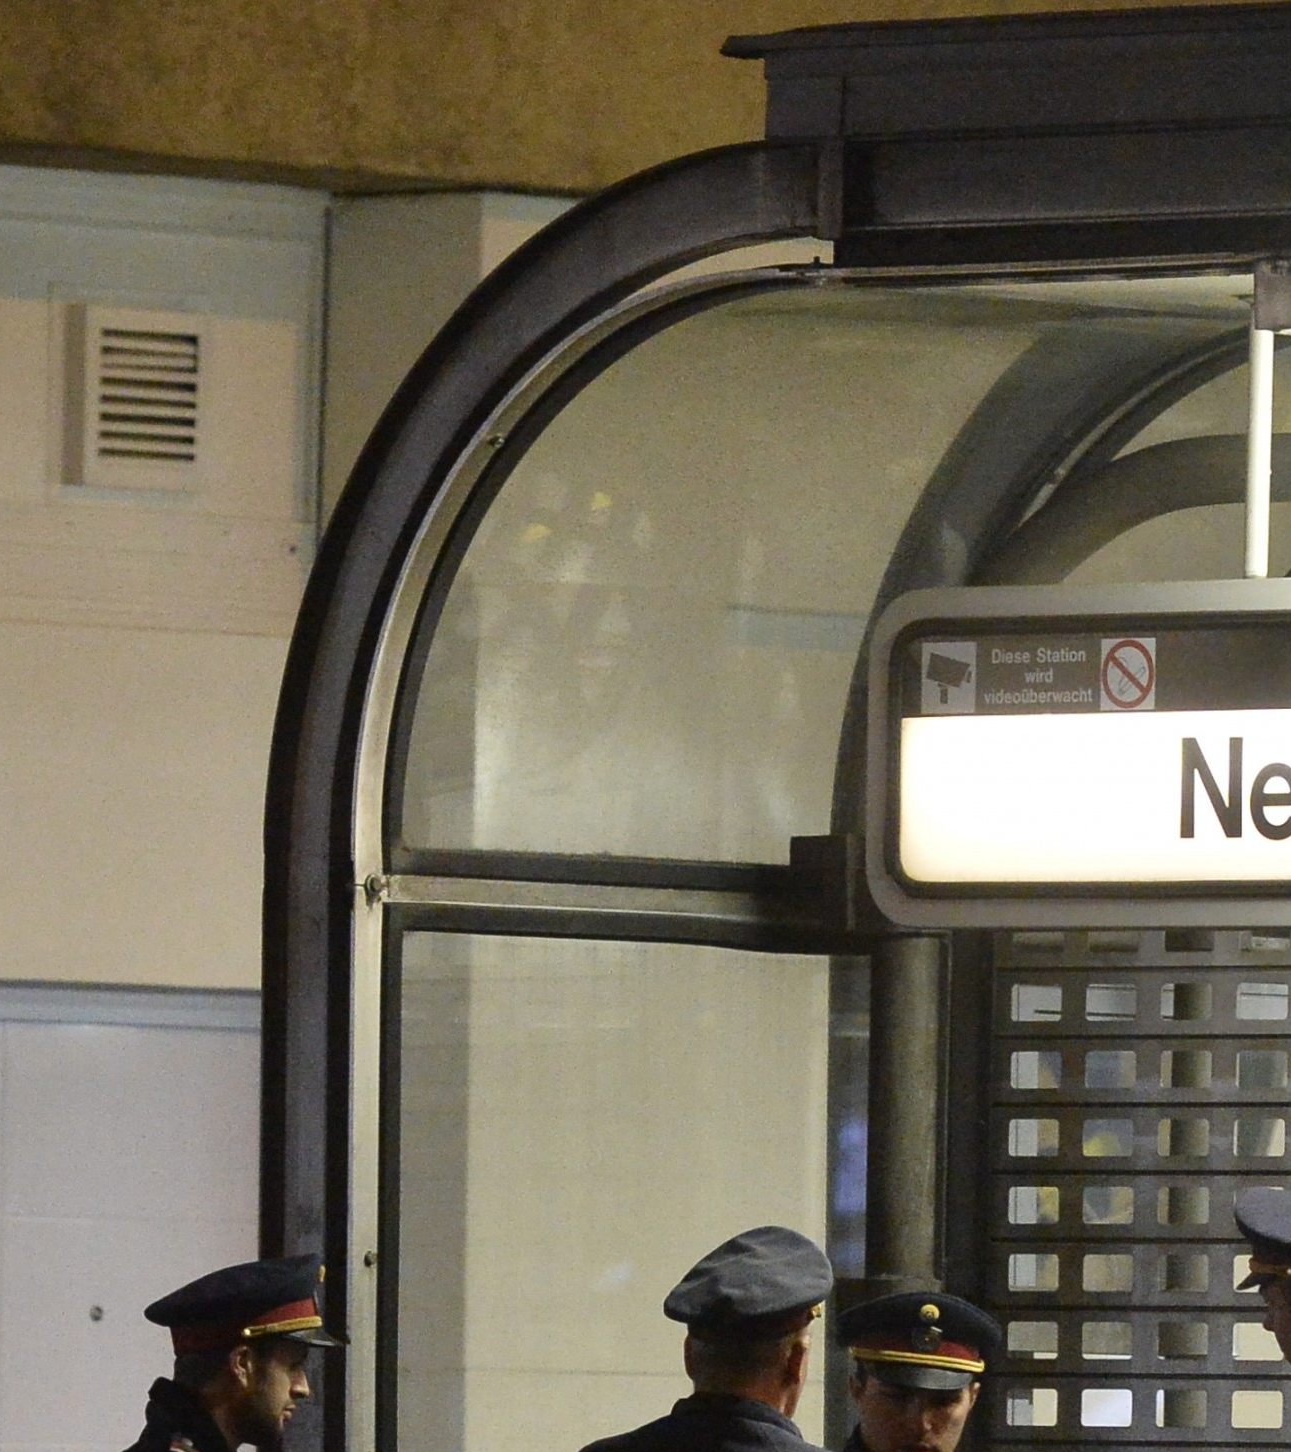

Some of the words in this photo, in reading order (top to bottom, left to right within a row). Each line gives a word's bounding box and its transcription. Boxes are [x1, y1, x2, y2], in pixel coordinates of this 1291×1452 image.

[992, 648, 1030, 664] Diese
[1036, 647, 1086, 663] Station
[1024, 667, 1053, 683] wird
[984, 688, 1093, 705] videoüberwacht
